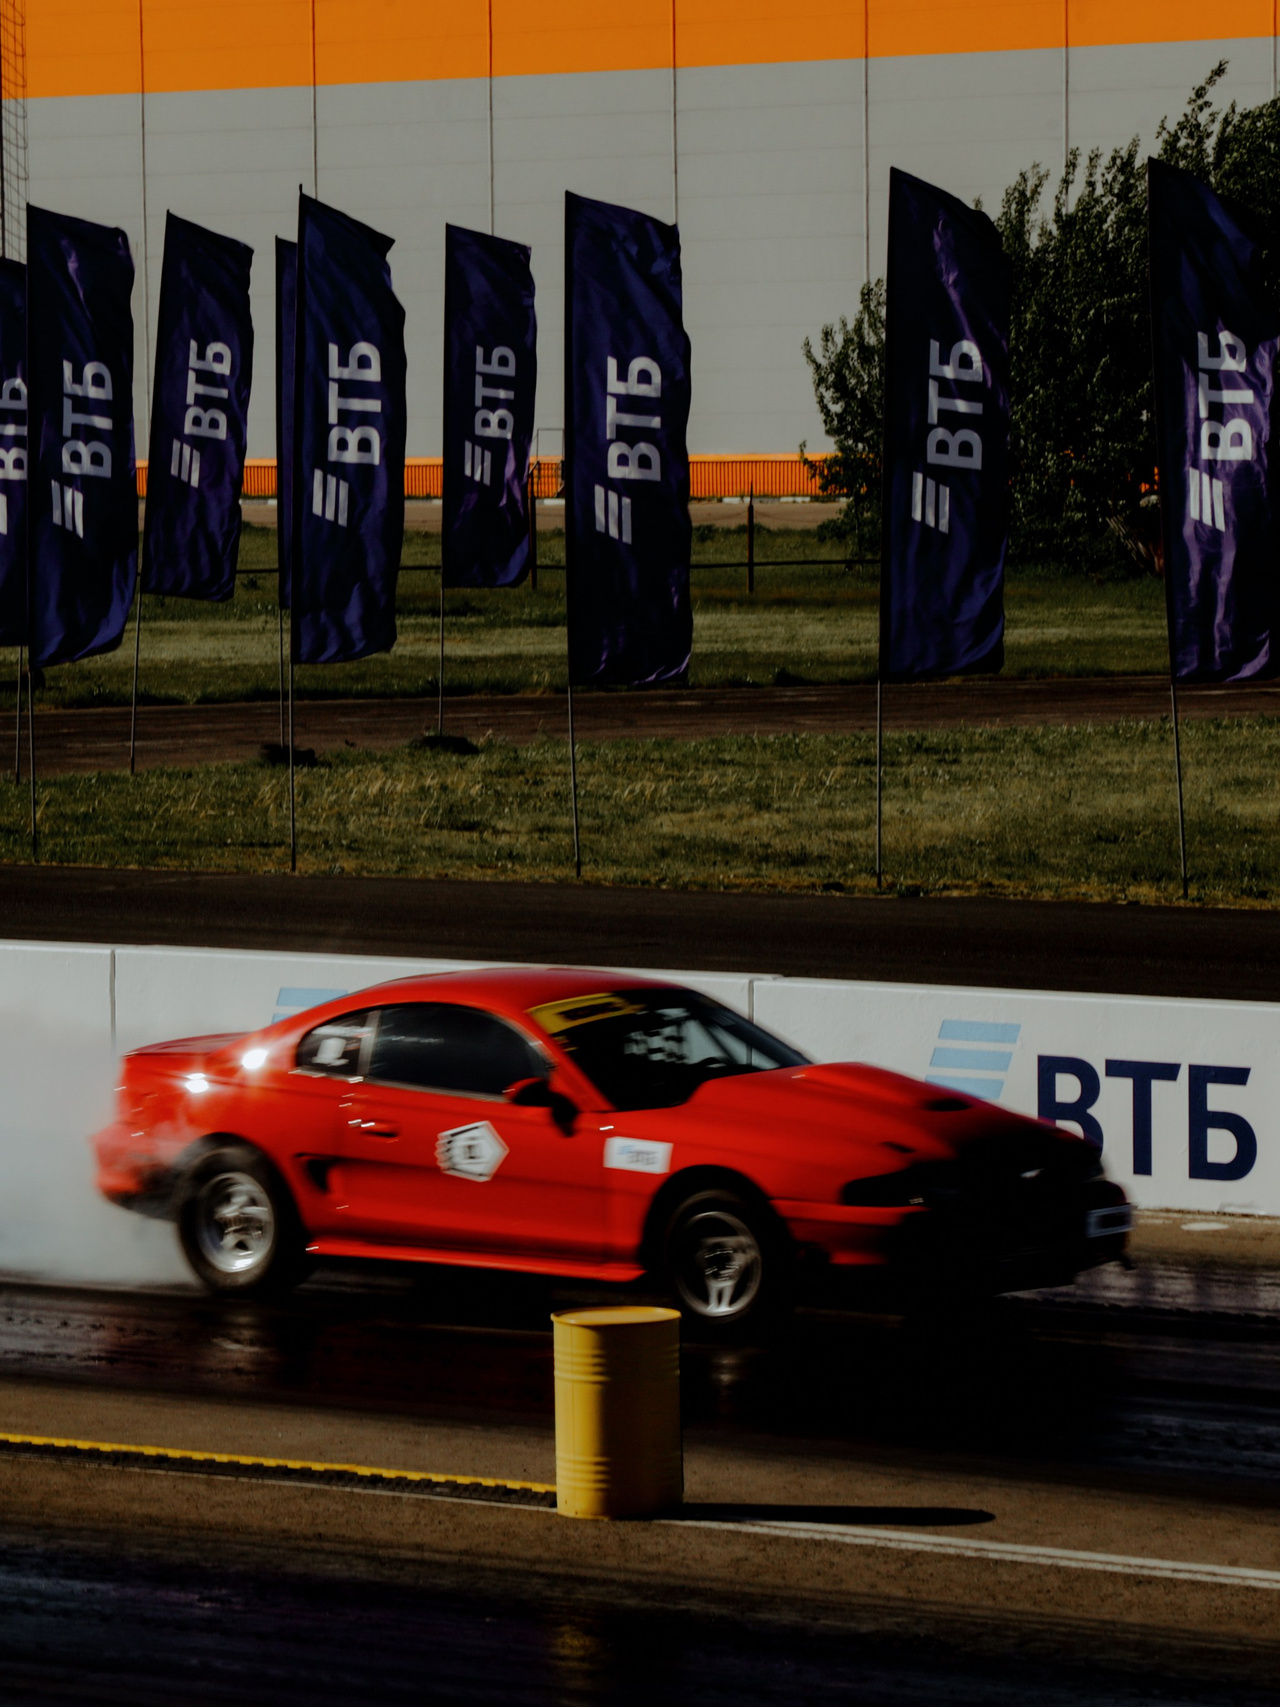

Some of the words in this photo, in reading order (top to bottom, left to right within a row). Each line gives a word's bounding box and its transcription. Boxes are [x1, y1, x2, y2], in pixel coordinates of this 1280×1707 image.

[62, 357, 113, 479] ВТБ
[184, 339, 232, 440] ВТБ
[327, 341, 381, 465] ВТБ
[475, 344, 516, 440] ВТБ
[607, 355, 661, 482] ВТБ
[927, 338, 983, 471] ВТБ
[1198, 330, 1254, 461] ВТБ
[1037, 1055, 1257, 1180] ВТБ
